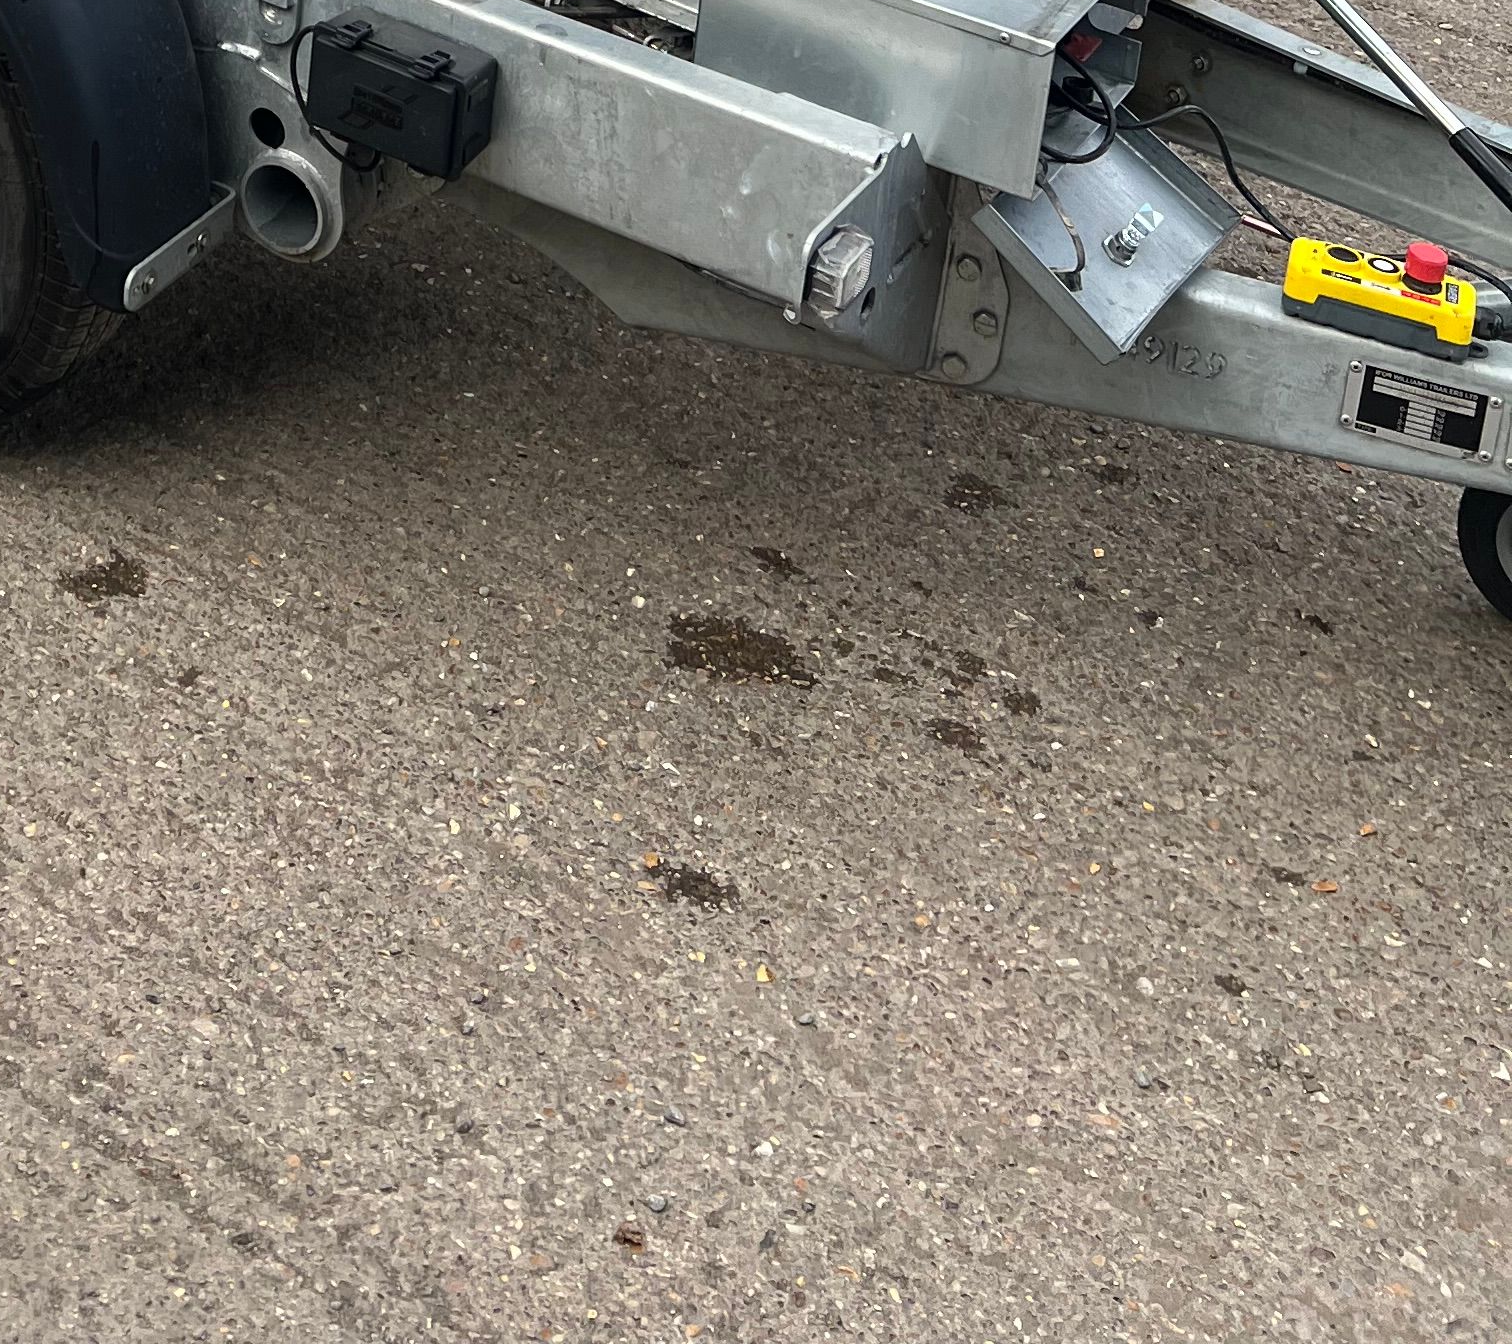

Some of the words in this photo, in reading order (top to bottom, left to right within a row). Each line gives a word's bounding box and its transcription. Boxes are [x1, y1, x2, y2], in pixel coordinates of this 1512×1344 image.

[1393, 374, 1428, 390] WILLIAMS
[1429, 382, 1464, 398] TRAILERS
[1465, 392, 1479, 401] LTD
